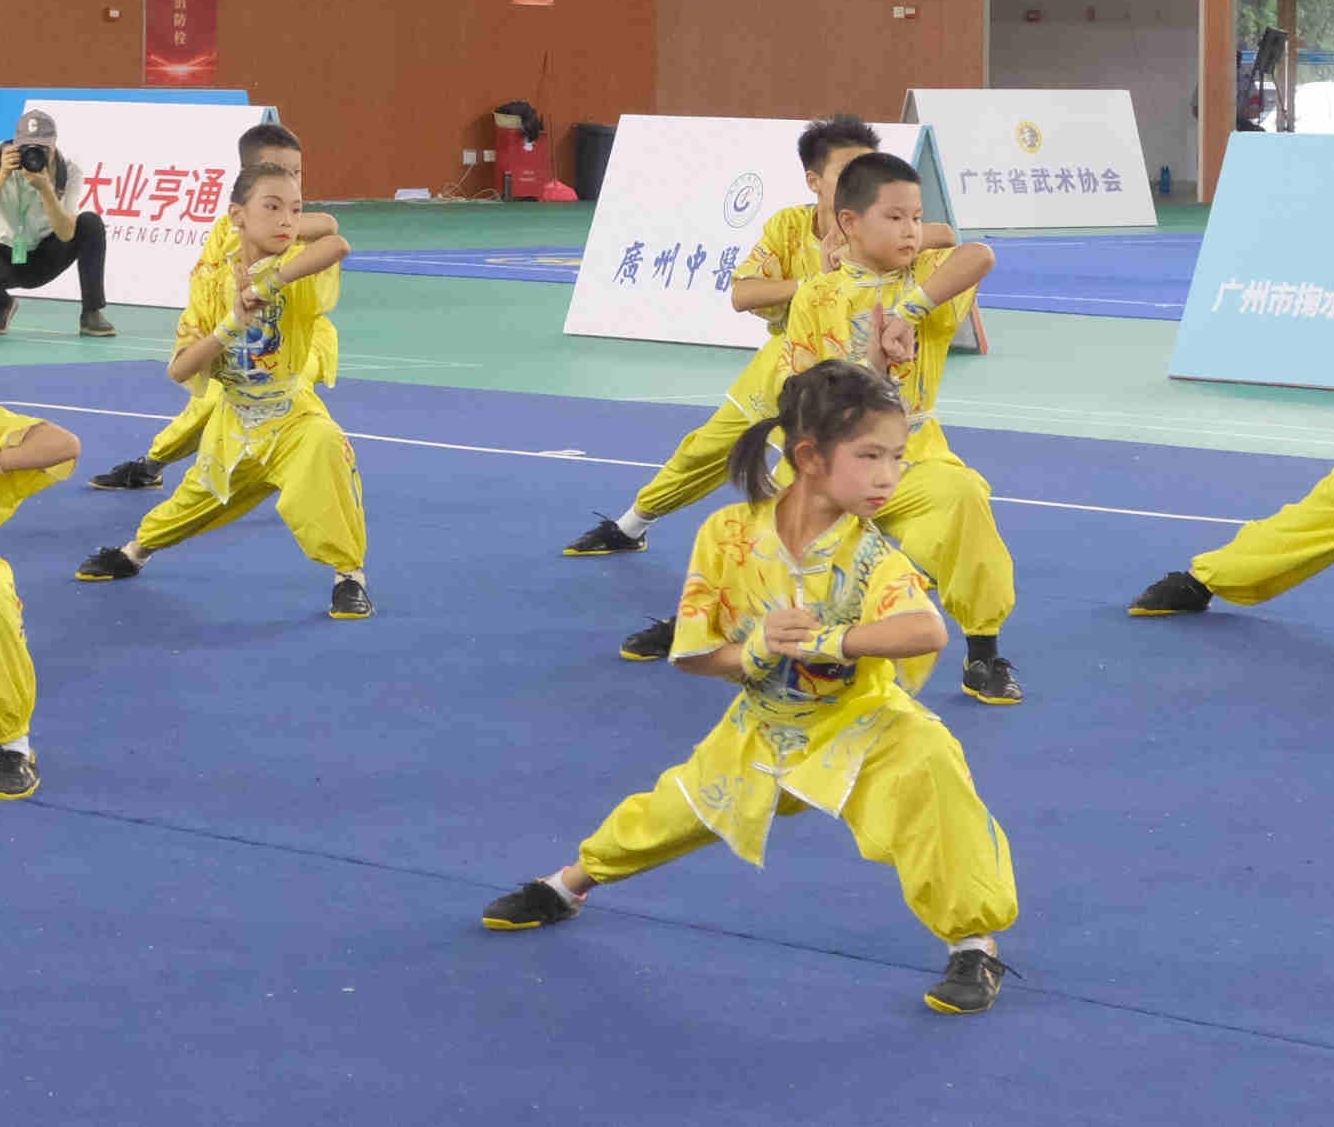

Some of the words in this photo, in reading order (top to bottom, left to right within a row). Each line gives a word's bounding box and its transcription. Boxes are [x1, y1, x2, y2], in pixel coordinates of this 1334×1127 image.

[78, 161, 227, 223] 大业亨通
[960, 167, 1124, 195] 广东省武术协会
